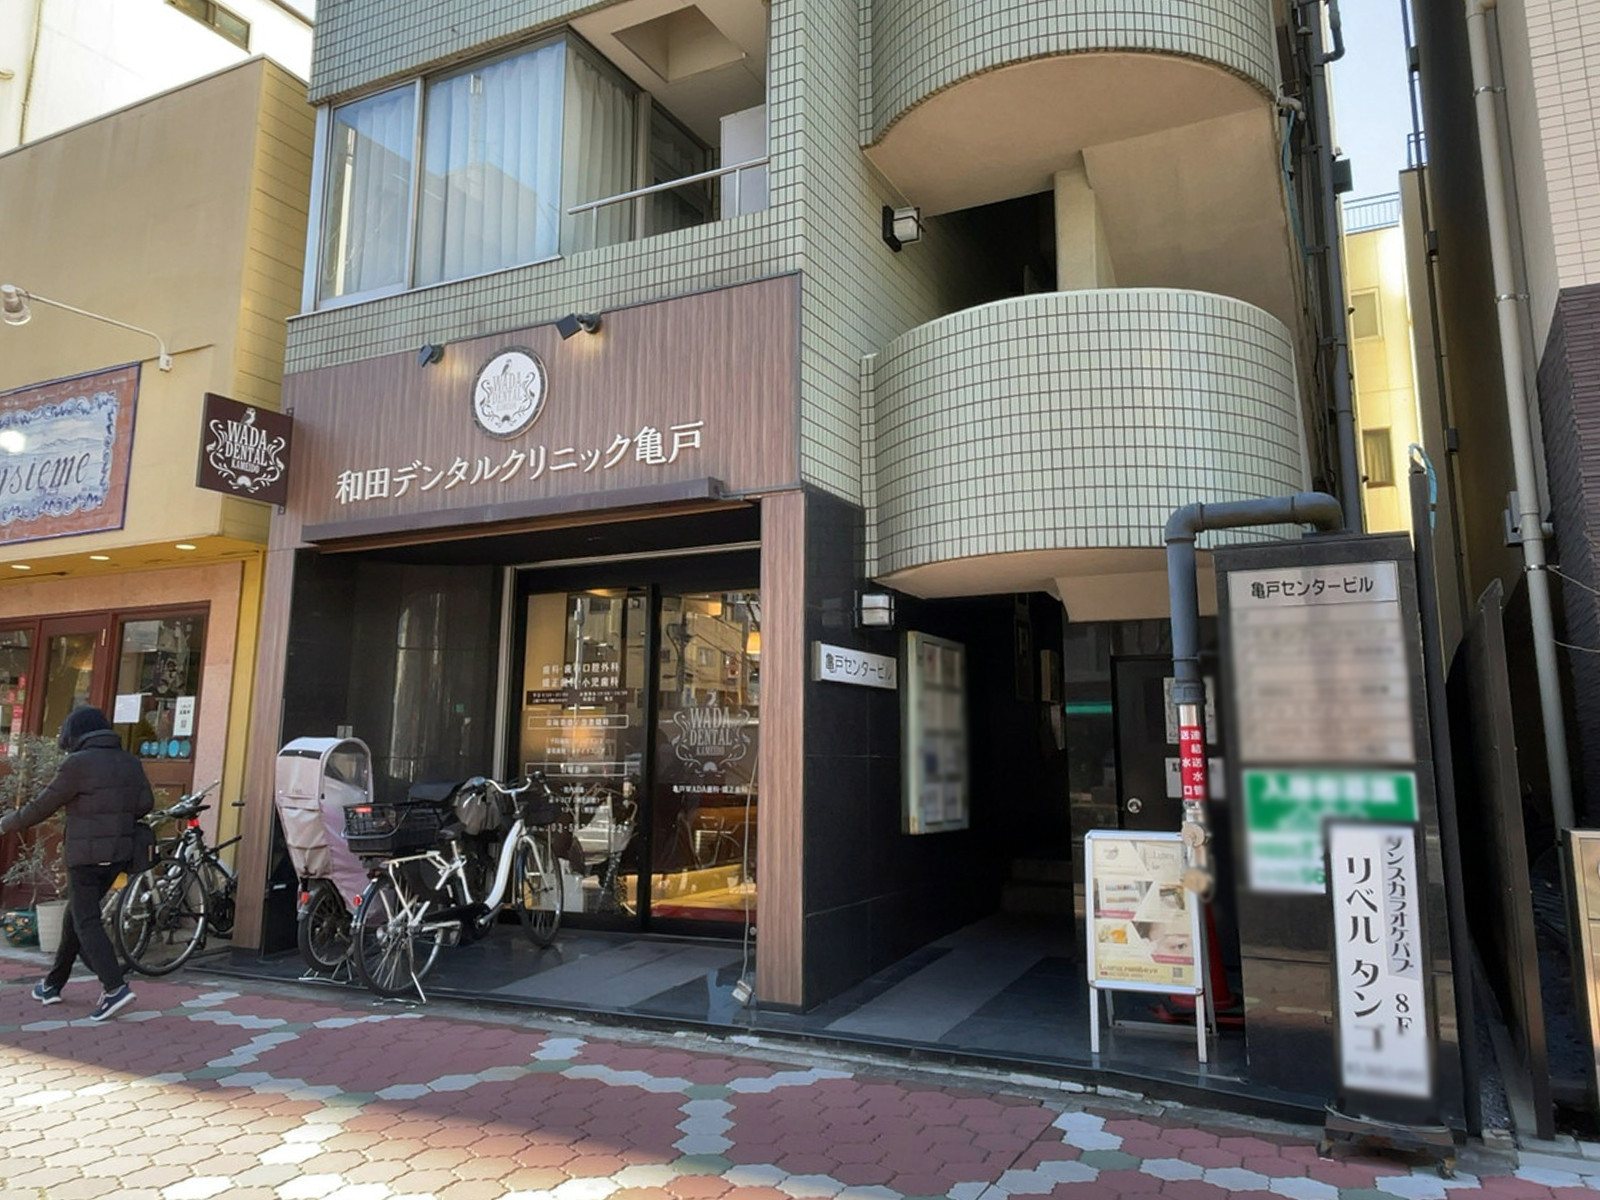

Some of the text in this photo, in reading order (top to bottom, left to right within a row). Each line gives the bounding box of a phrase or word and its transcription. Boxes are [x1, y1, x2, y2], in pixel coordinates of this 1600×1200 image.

[226, 419, 268, 451] WADA
[225, 440, 268, 467] DENTAL
[335, 420, 704, 504] 和田デンタルクリニック亀戸
[1251, 576, 1374, 599] 亀戸センタービル
[826, 653, 894, 681] 亀戸センタービル
[690, 707, 731, 729] WADA
[690, 729, 732, 746] DENTAL
[1180, 730, 1193, 795] 送水口
[1395, 993, 1413, 1036] 8F
